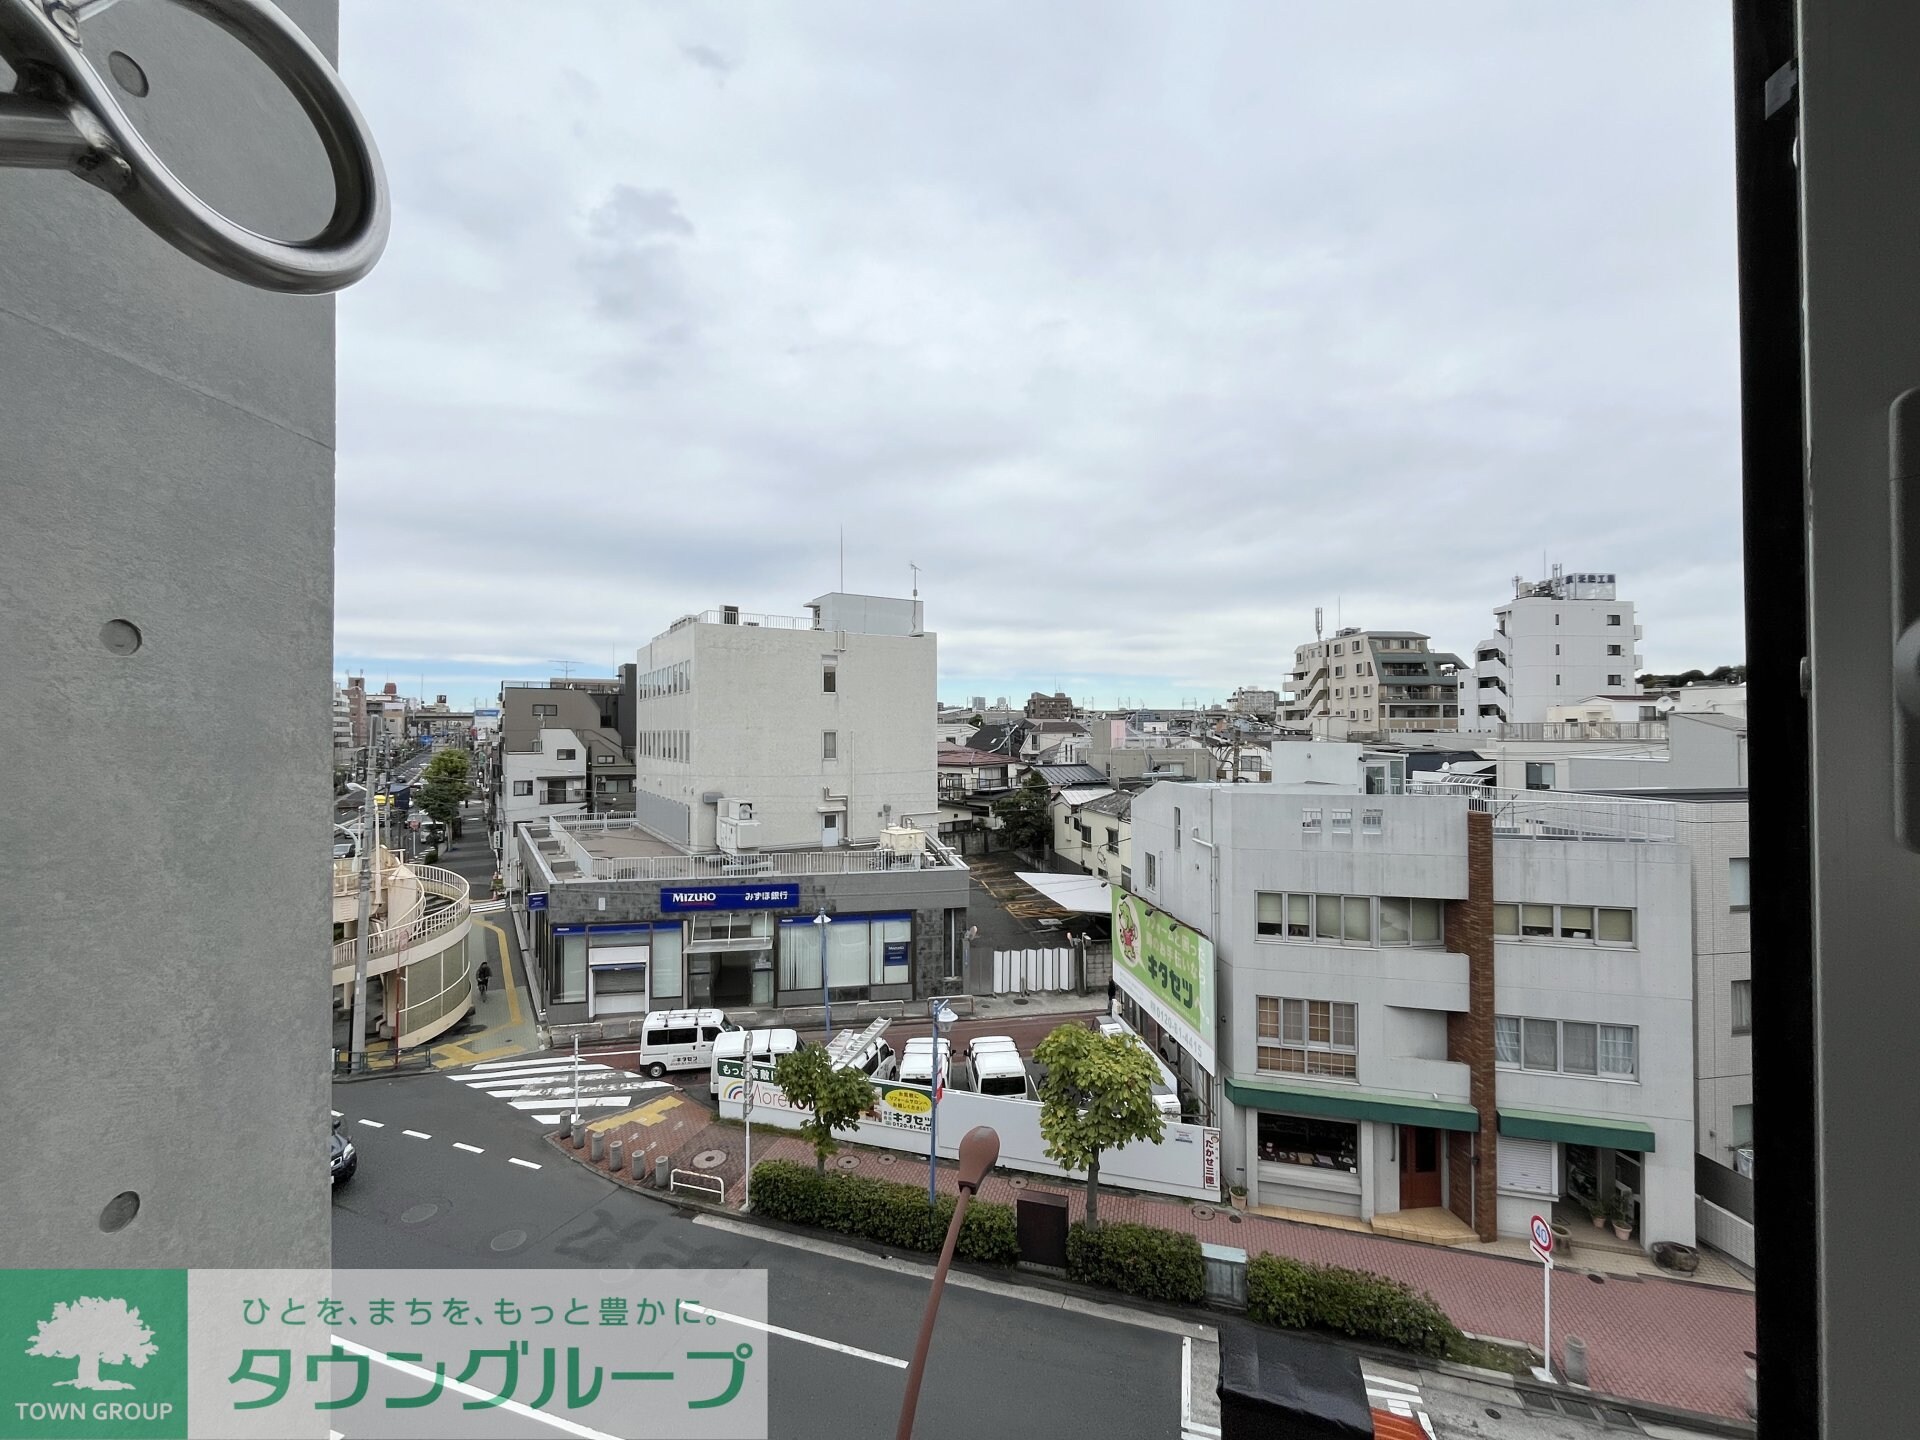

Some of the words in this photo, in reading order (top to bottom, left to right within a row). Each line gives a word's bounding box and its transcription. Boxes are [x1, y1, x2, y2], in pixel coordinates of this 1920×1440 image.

[672, 892, 716, 902] MIZUHO
[745, 891, 788, 900] みずほ銀行
[893, 1113, 932, 1126] キタセツ
[1536, 1226, 1547, 1242] 40
